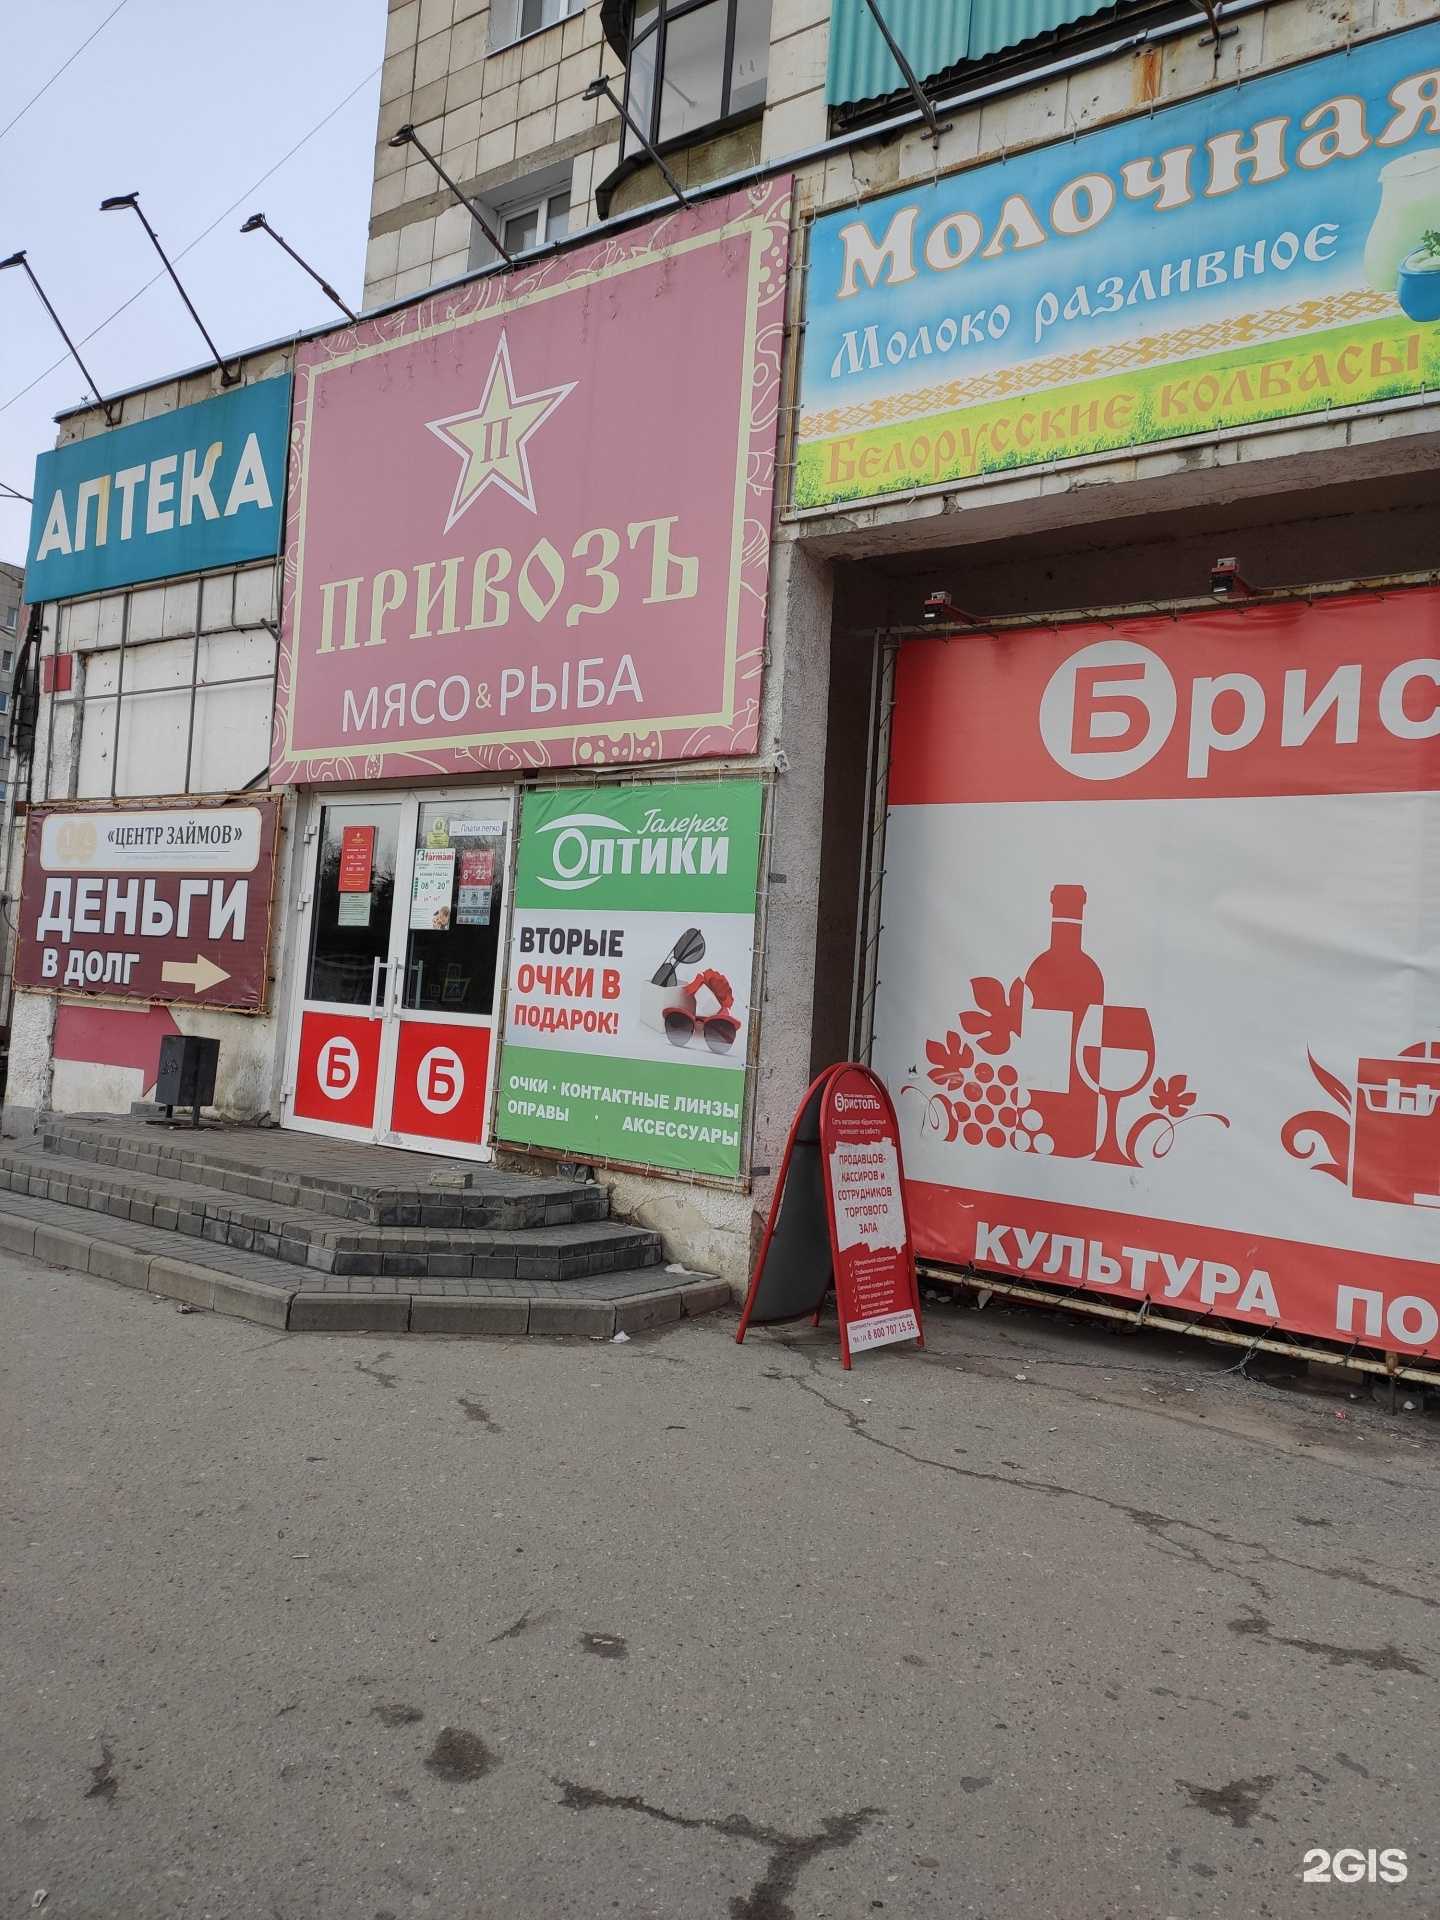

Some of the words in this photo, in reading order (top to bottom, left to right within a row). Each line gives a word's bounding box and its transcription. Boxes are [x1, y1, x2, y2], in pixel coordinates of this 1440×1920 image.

[836, 69, 1440, 300] Молочная
[830, 304, 1011, 378] Молоко
[1035, 223, 1340, 343] разливное
[825, 393, 1137, 485] Белорусские
[1161, 334, 1422, 419] колбасы
[36, 432, 273, 562] АПТЕКА
[315, 515, 700, 655] ПРИВОЗЪ
[107, 827, 164, 849] «ЦЕНТР
[166, 821, 243, 845] ЗАЙМОВ»
[637, 808, 730, 842] Галерея
[36, 877, 249, 943] ДЕНЬГИ
[519, 927, 625, 958] ВТОРЫЕ
[42, 948, 58, 978] В
[64, 950, 141, 987] ДОЛГ
[517, 964, 594, 999] ОЧКИ
[602, 968, 622, 1000] В
[514, 1004, 620, 1035] ПОДАРОК!
[326, 1046, 352, 1088] Б
[427, 1058, 456, 1101] Б
[509, 1075, 549, 1094] ОЧКИ
[560, 1081, 671, 1111] КОНТАКТНЫЕ
[673, 1094, 740, 1120] ЛИНЗЫ
[835, 1092, 881, 1112] Бристоль
[507, 1099, 570, 1122] ОПРАВЫ
[622, 1116, 740, 1147] АКСЕССУАРЫ
[839, 1154, 886, 1166] ПРОДАВЦОВ-
[841, 1171, 879, 1182] КАССИРОВ
[838, 1187, 892, 1201] СОТРУДНИКОВ
[844, 1204, 888, 1218] ТОРГОВОГО
[859, 1222, 878, 1234] ЗАЛА
[974, 1221, 1281, 1317] КУЛЬТУРА
[1335, 1284, 1439, 1345] ПО
